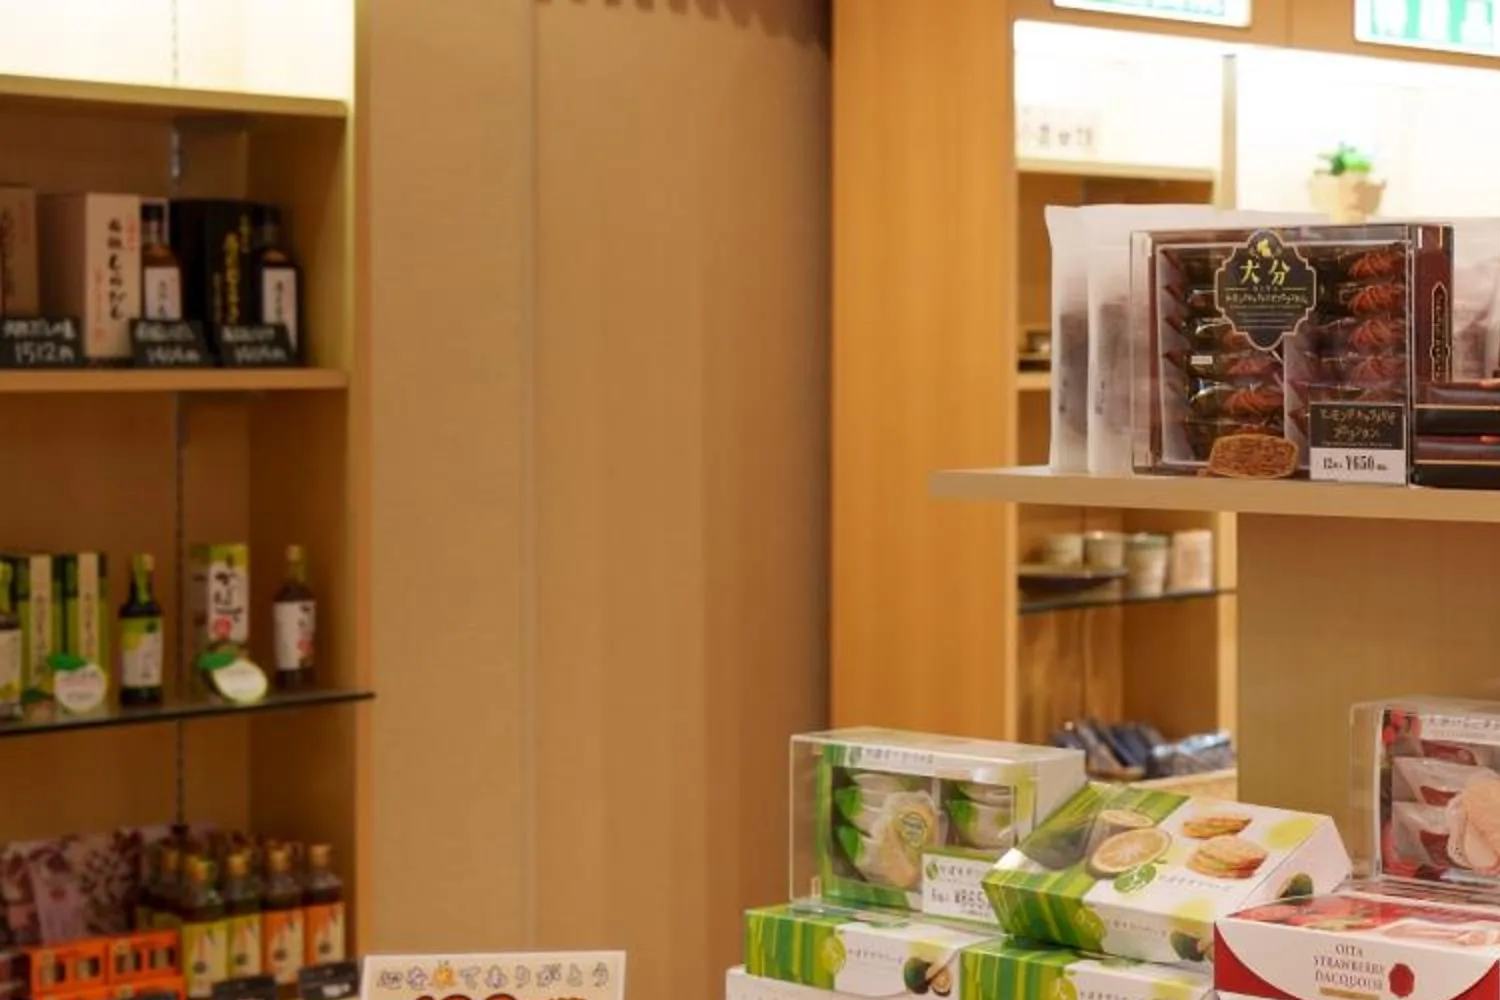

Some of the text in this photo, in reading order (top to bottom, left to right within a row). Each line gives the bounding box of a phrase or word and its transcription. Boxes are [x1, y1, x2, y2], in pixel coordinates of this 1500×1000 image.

[1239, 259, 1291, 285] 大分
[1336, 943, 1363, 957] OITA
[1313, 955, 1386, 976] STRAWBERRY
[1315, 971, 1384, 992] DACQUOISE
